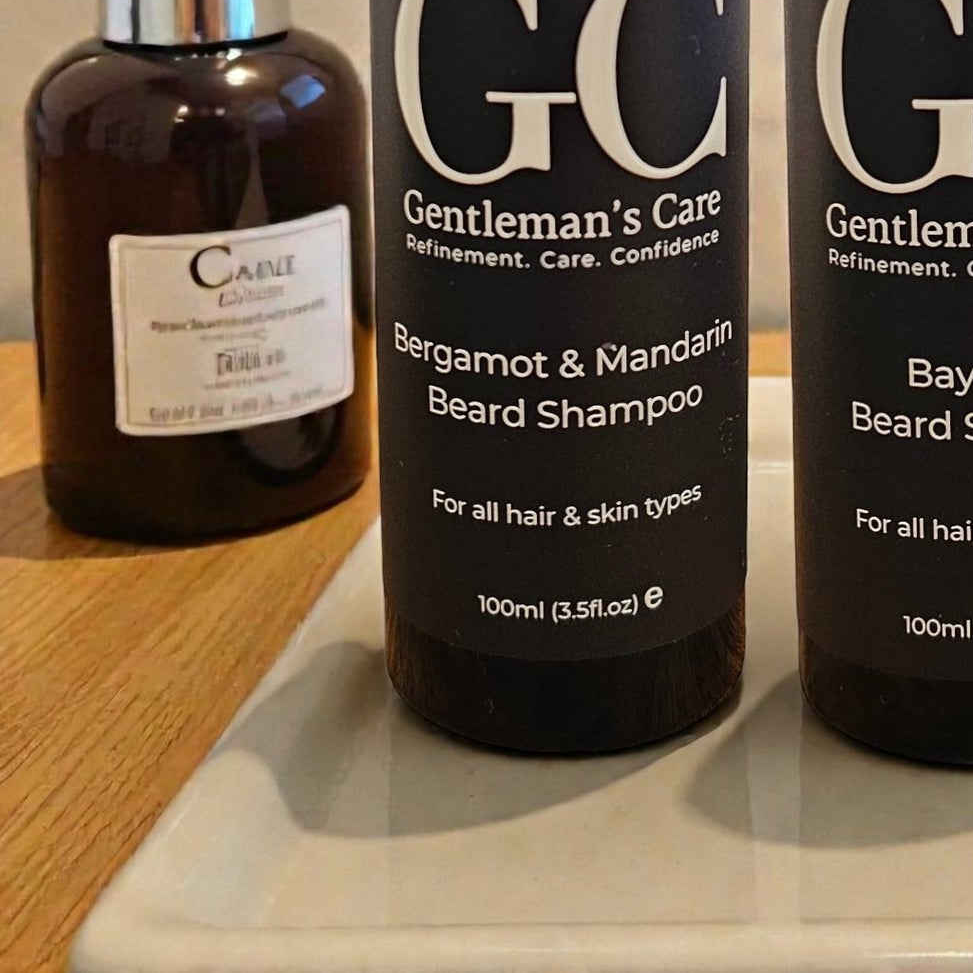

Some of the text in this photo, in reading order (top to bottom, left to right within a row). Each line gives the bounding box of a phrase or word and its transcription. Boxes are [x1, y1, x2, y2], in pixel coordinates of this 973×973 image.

[404, 190, 721, 242] Gentleman's Care
[407, 227, 719, 269] Refinement. Care. Confidence
[829, 245, 957, 277] Refinement.
[395, 319, 732, 378] Bergamot & Mandarin
[429, 385, 702, 428] Beard Shampoo
[852, 401, 951, 440] Beard
[433, 485, 701, 526] For all hair & skin types
[857, 509, 891, 533] For
[898, 518, 924, 538] all
[478, 595, 544, 619] 100ml
[552, 594, 638, 623] (3.5fl.oz)
[903, 616, 970, 638] 100ml
